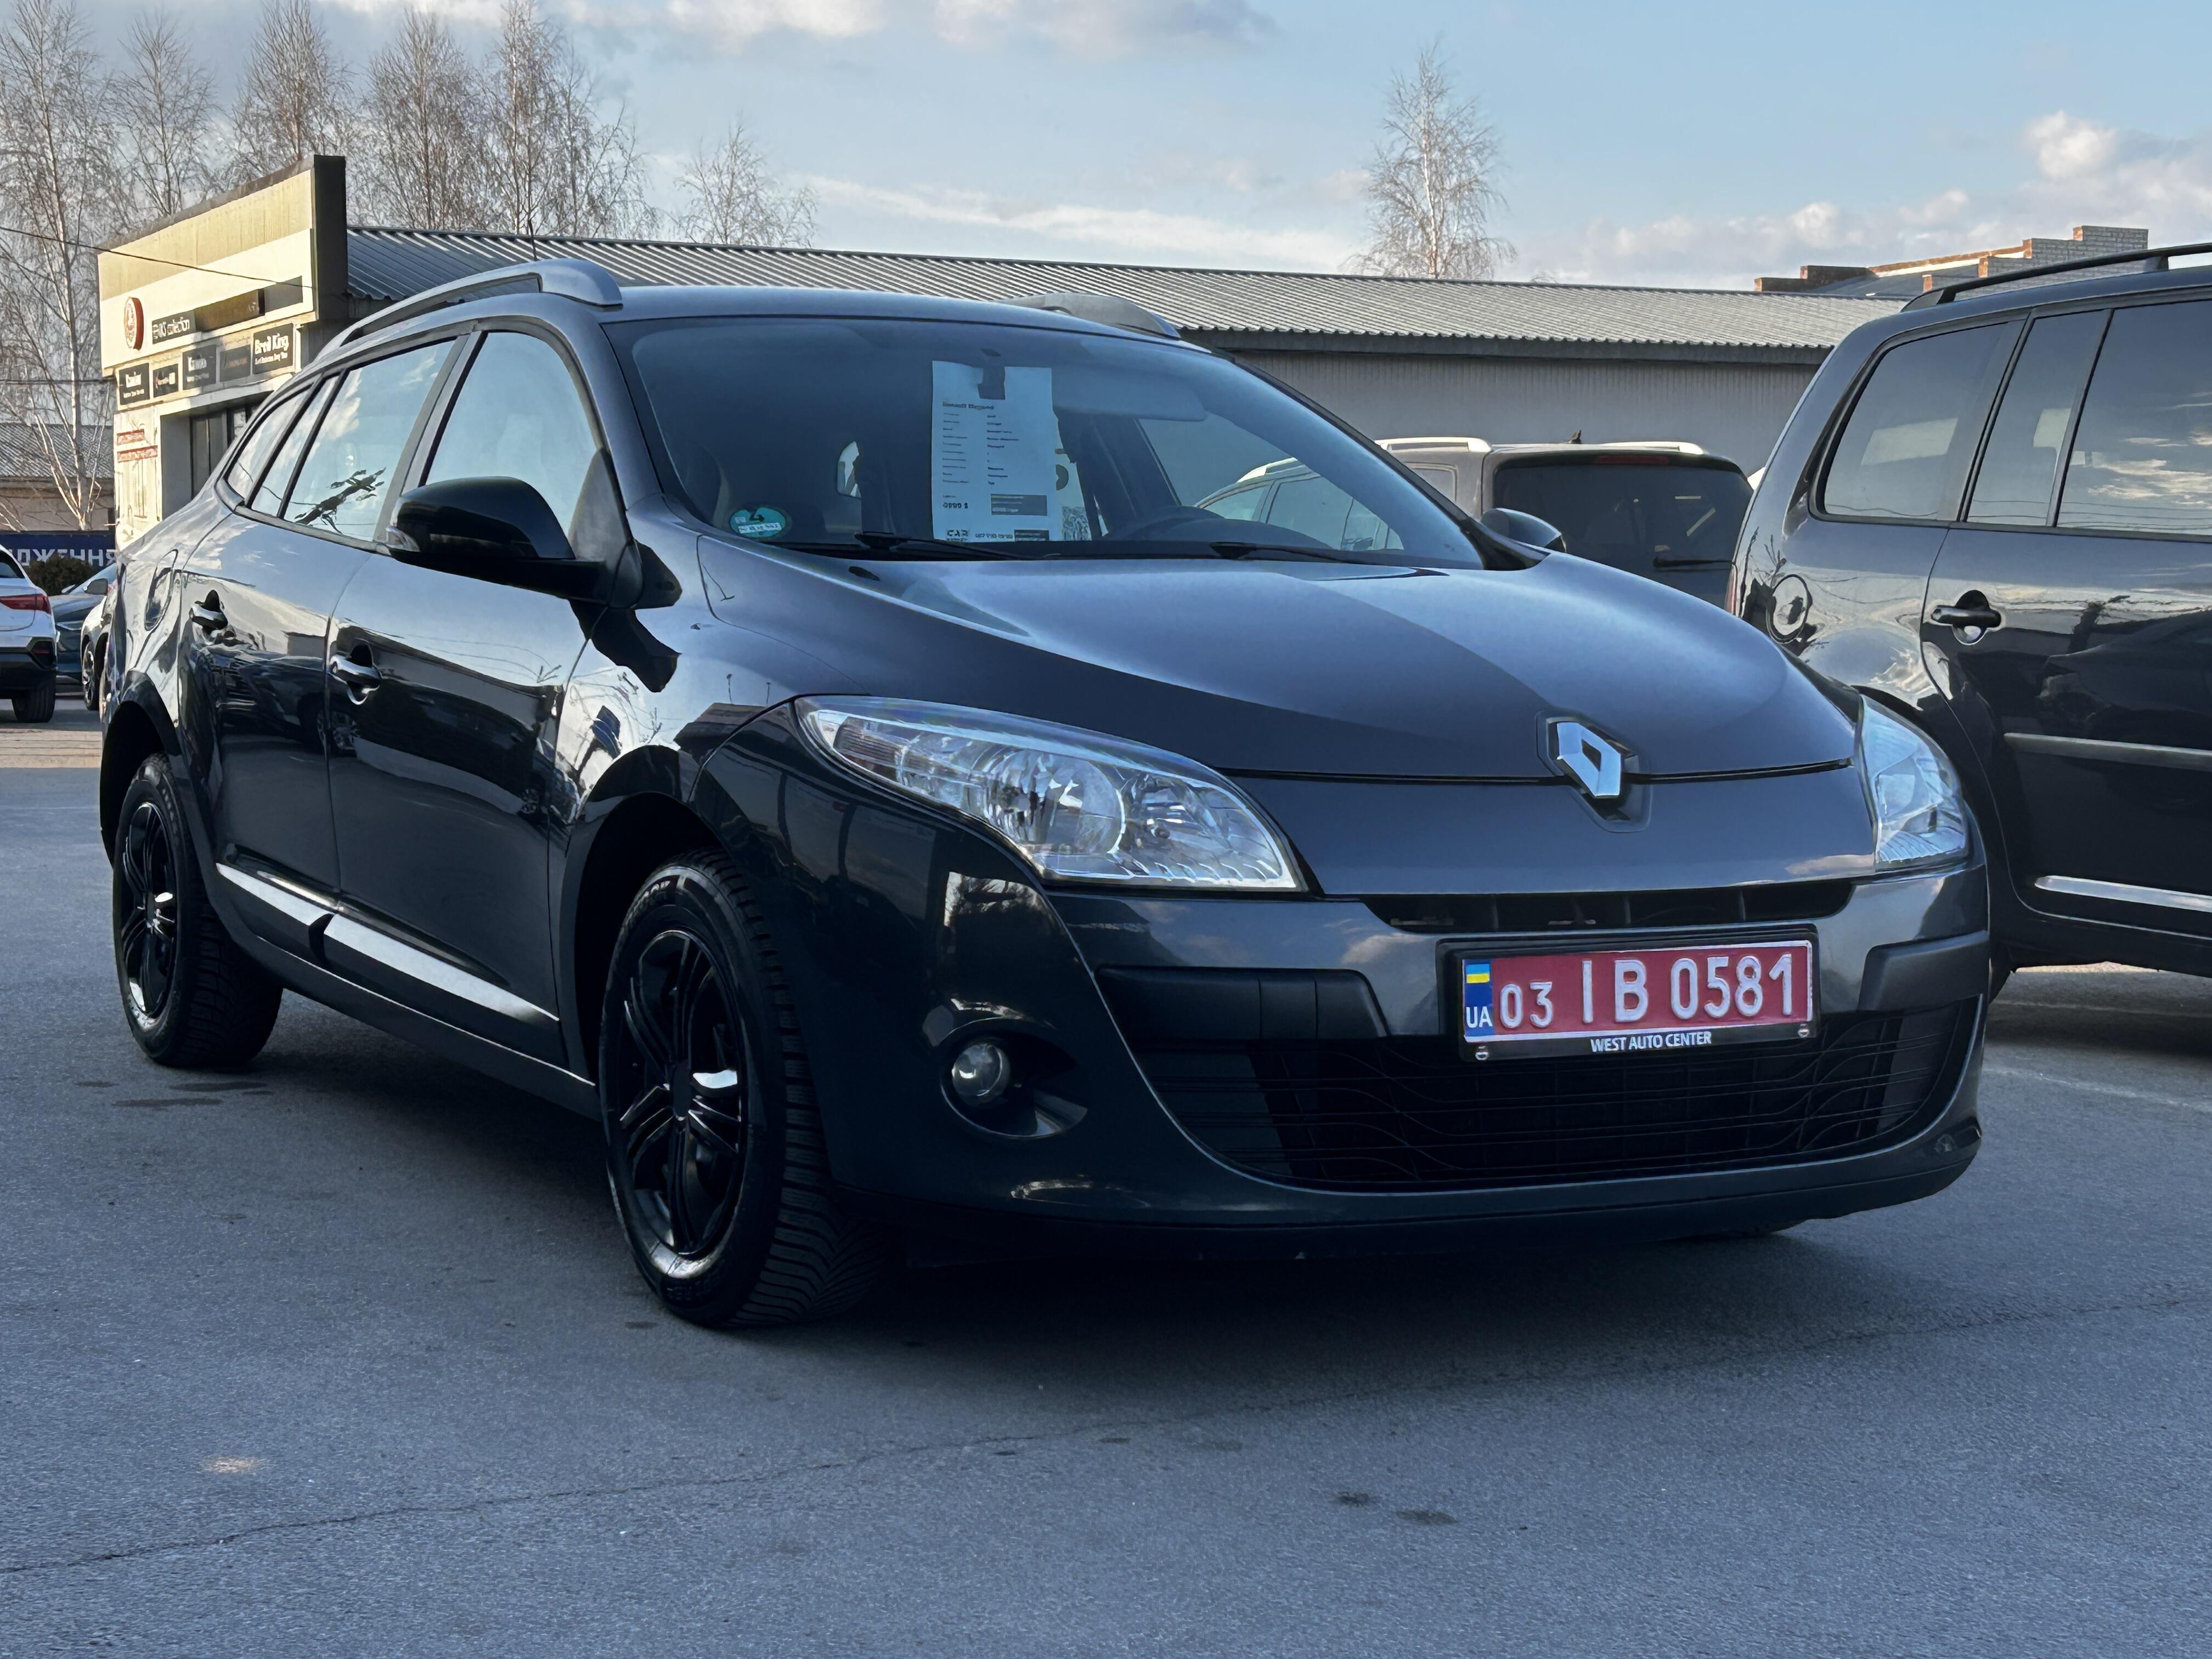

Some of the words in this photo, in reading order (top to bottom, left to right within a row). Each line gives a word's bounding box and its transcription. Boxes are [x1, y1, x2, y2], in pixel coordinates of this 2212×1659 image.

[9, 549, 116, 567] ДЖННЯ
[1500, 981, 1554, 1029] 03
[1669, 953, 1793, 1020] 0581
[1466, 1006, 1493, 1028] UA
[1590, 1037, 1626, 1052] WEST
[1628, 1035, 1663, 1050] AUTO
[1665, 1031, 1712, 1047] CENTER
